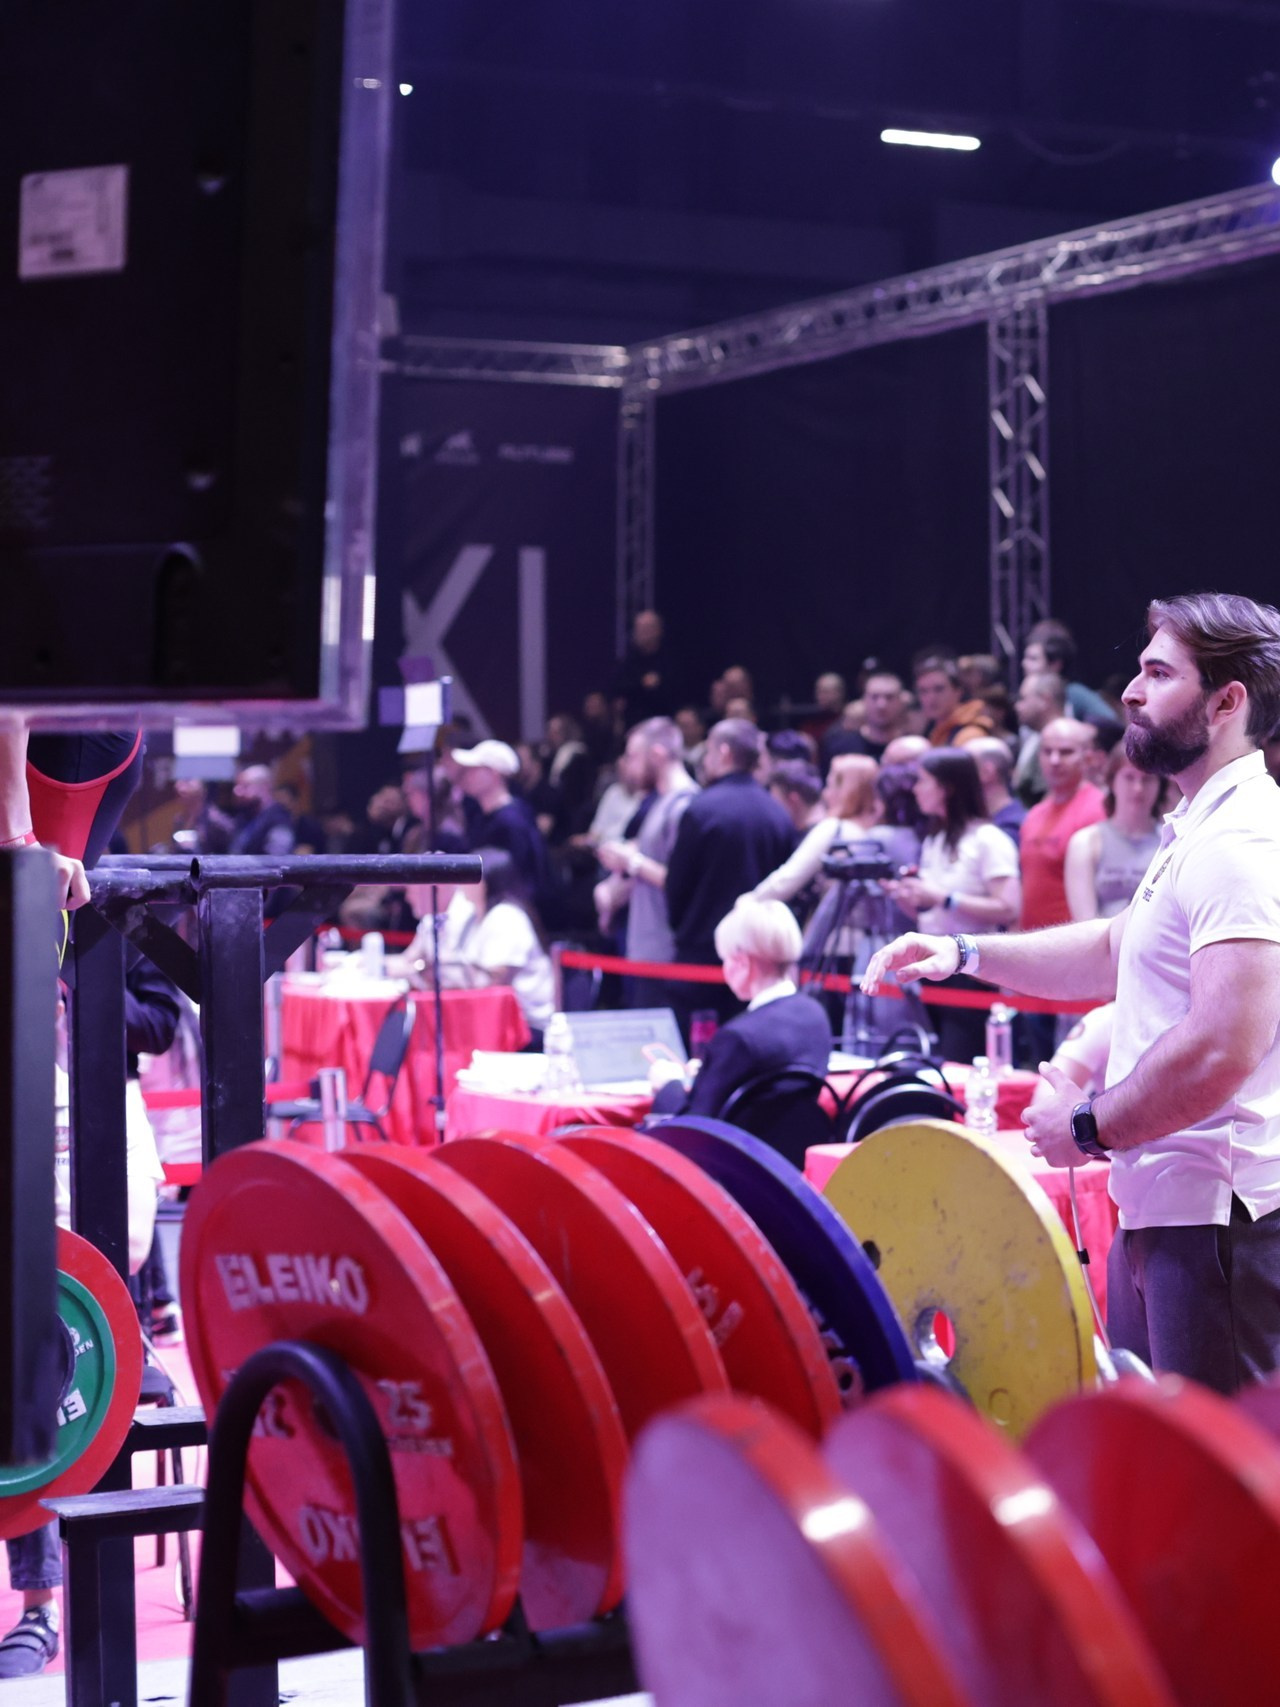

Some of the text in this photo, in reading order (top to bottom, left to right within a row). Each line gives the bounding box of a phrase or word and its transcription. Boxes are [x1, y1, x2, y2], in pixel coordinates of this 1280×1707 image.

[215, 1253, 370, 1316] ELEIKO
[377, 1379, 432, 1431] 25
[299, 1504, 451, 1574] ELKO
